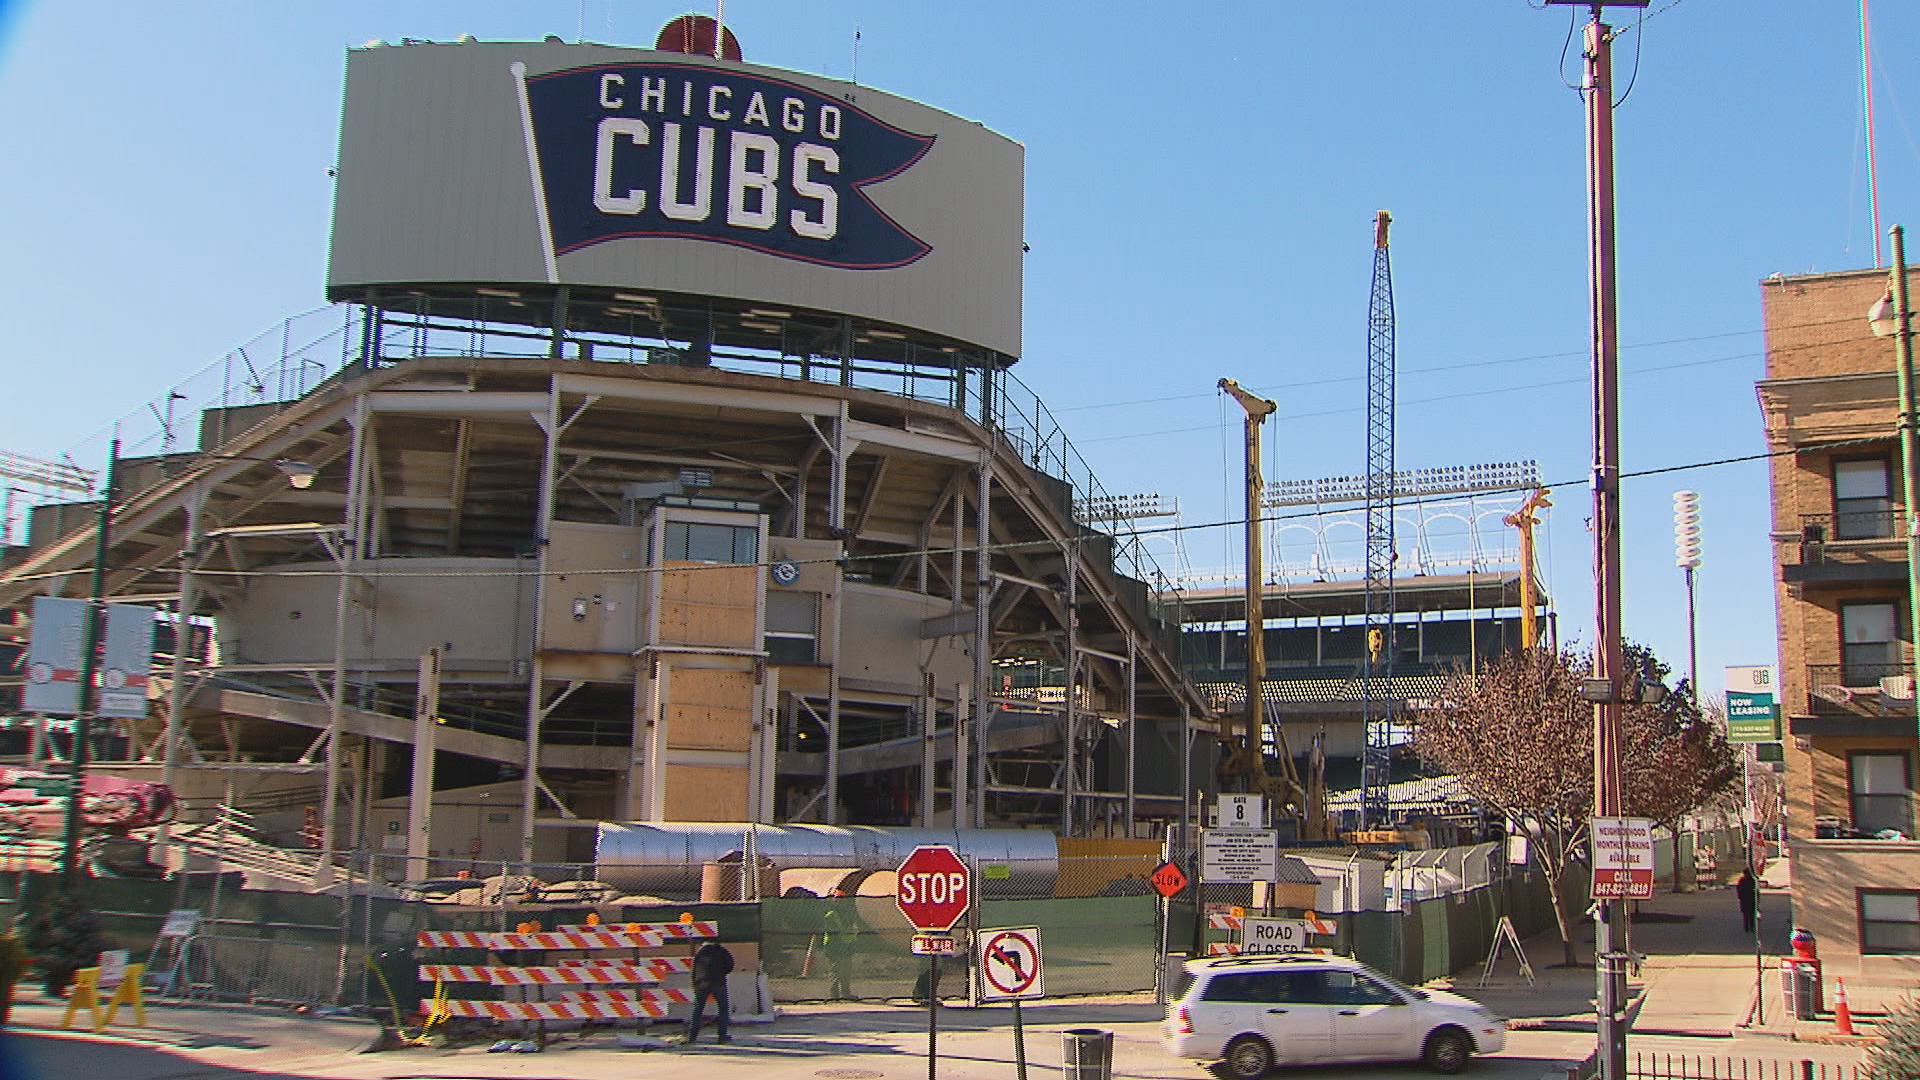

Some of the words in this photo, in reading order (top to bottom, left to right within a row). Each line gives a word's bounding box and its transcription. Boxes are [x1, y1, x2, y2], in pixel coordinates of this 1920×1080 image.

[600, 73, 842, 140] CHICAGO
[593, 117, 841, 241] CUBS
[1730, 698, 1752, 706] NOW
[1730, 706, 1770, 716] LEASING
[1233, 796, 1247, 804] GATE
[1236, 804, 1244, 820] 8
[1596, 840, 1623, 849] MONTHLY
[1624, 840, 1650, 849] PARKING
[1156, 873, 1181, 887] SLOW
[1613, 871, 1632, 883] CALL
[901, 872, 965, 904] STOP
[1256, 925, 1293, 940] ROAD
[1248, 943, 1298, 955] CLOSED
